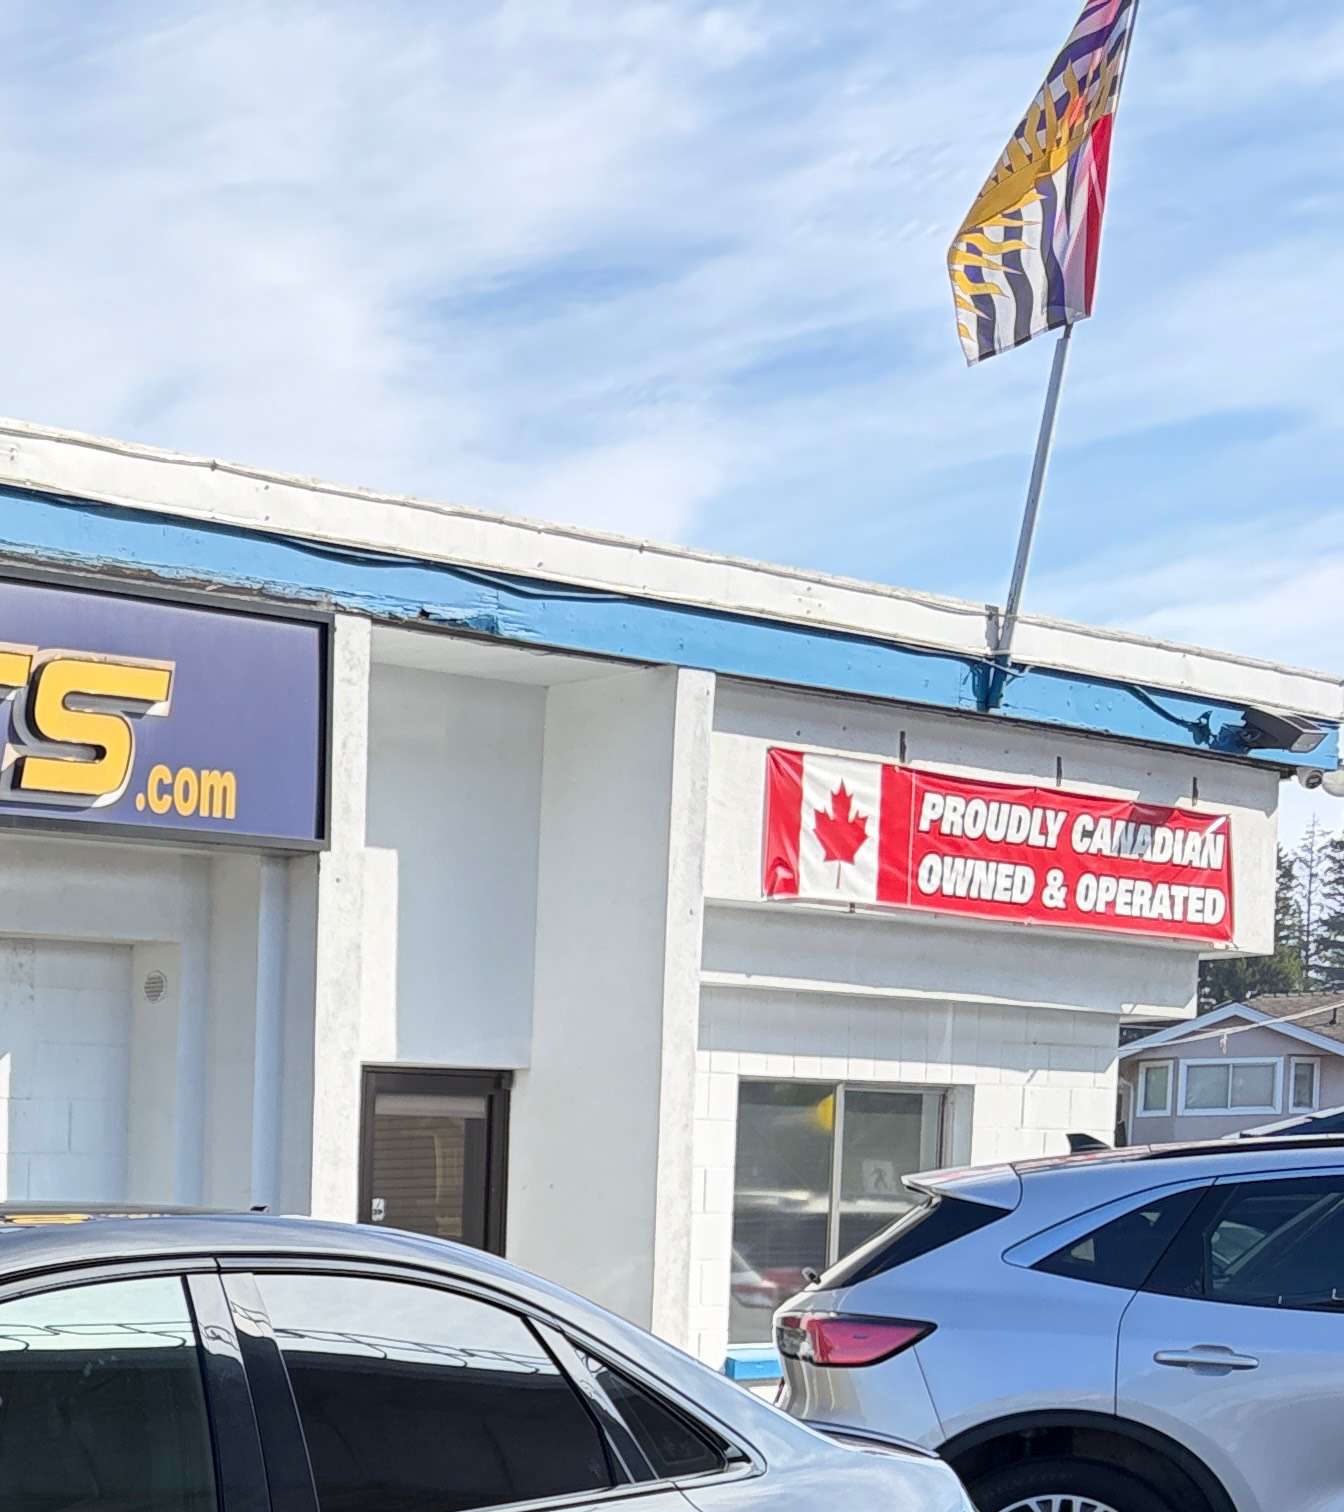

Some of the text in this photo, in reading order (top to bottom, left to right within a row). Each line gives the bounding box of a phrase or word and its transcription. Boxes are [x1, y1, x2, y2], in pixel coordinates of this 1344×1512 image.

[134, 761, 237, 820] .com
[918, 792, 1226, 870] PROUDLY CANADIAN
[918, 854, 1226, 925] OWNED & OPERATED
